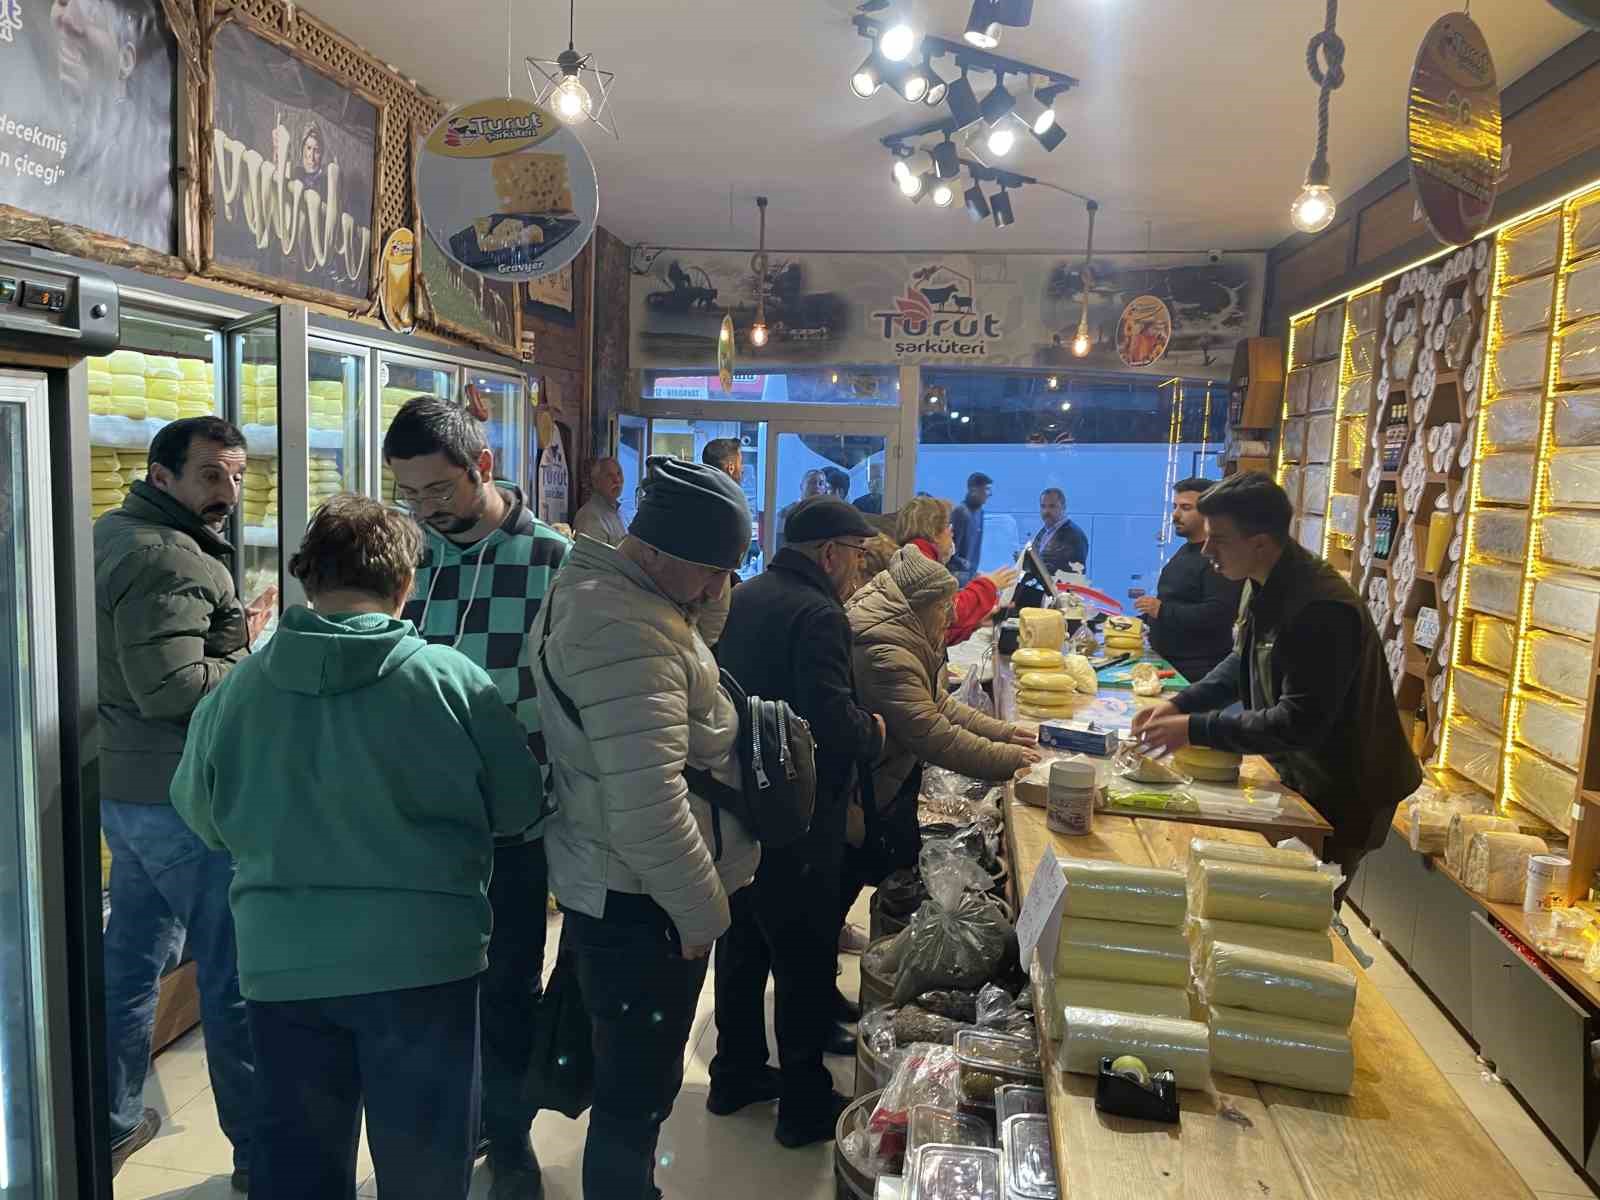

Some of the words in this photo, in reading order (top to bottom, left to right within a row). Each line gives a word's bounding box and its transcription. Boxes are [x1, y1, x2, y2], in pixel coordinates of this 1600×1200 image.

[470, 112, 544, 136] Turut
[873, 312, 1001, 339] Turut
[895, 339, 985, 356] şarküteri
